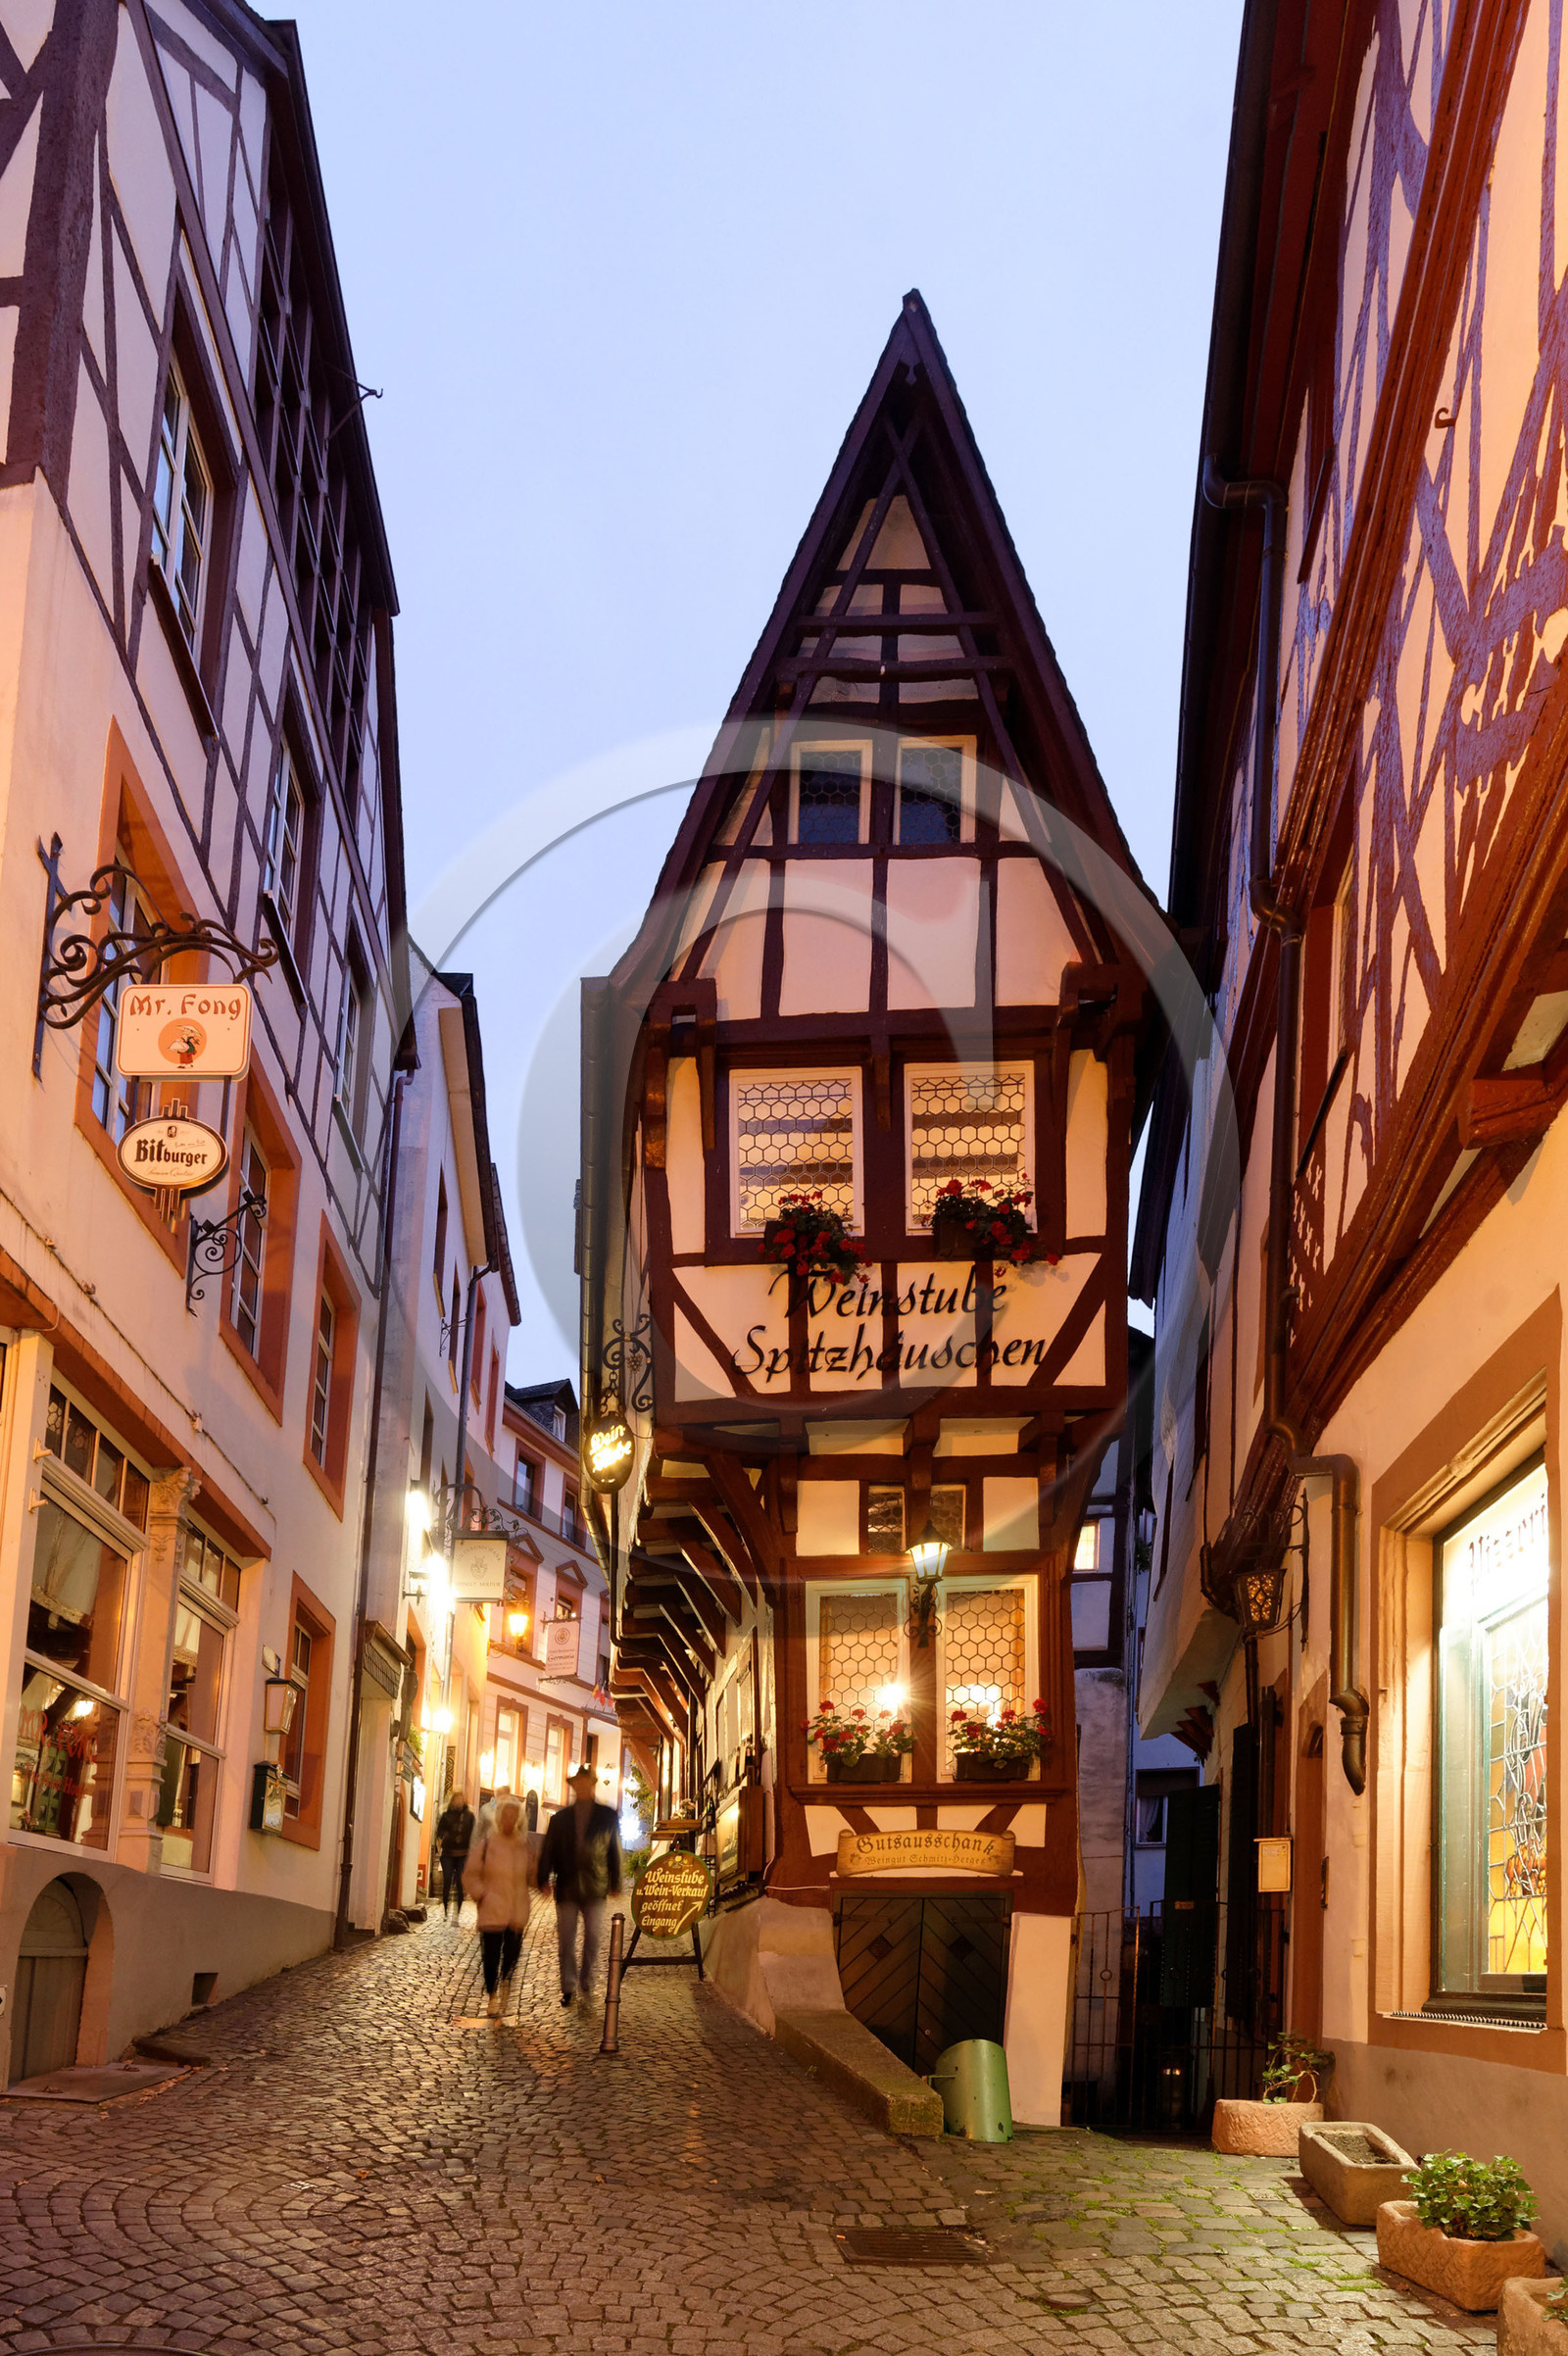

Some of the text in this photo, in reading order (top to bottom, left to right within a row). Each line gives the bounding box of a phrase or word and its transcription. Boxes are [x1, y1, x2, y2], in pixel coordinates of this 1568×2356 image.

[129, 994, 242, 1020] Mr. Fong
[134, 1138, 209, 1168] Bitburger
[767, 1263, 1008, 1319] Weinstube
[730, 1323, 1047, 1384] Spitzhäuschen
[857, 1832, 996, 1855] Gutsausschank
[865, 1855, 906, 1866] Weingut
[645, 1867, 705, 1884] Weinstube
[644, 1883, 710, 1898] Wein-Verkauf
[640, 1898, 685, 1913] geöffnet
[641, 1914, 678, 1933] Eingang
